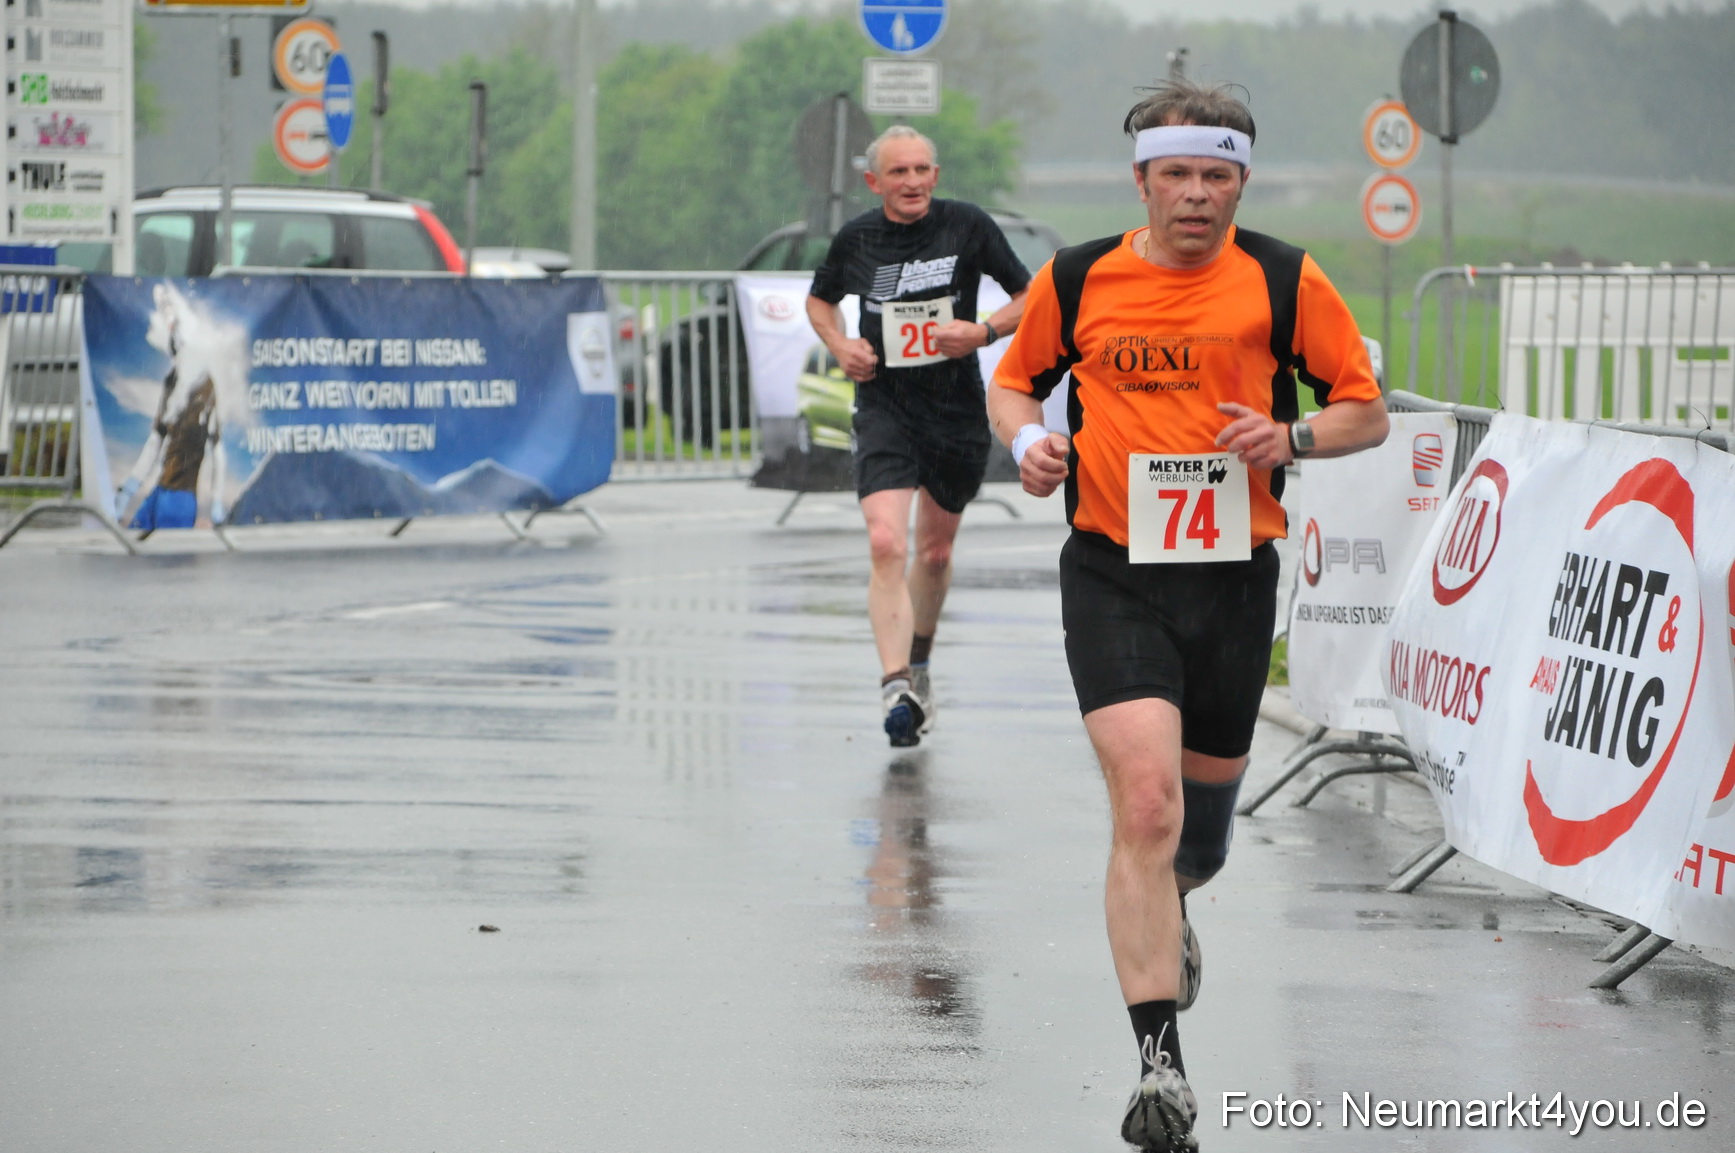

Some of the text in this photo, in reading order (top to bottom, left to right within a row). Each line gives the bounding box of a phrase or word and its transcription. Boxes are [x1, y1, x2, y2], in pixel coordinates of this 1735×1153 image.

[291, 40, 329, 75] 60
[1377, 119, 1410, 149] 60
[894, 305, 924, 313] MEYER
[252, 338, 376, 367] SAISONSTART
[380, 338, 413, 367] BEI
[1114, 347, 1200, 373] OEXL
[249, 382, 302, 410] GANZ
[413, 381, 445, 409] MIT
[446, 380, 517, 408] TOLLEN
[246, 423, 436, 453] WINTERANGEBOTEN
[1149, 460, 1204, 473] MEYER
[1149, 473, 1204, 483] WERBUNG
[1158, 488, 1220, 550] 74
[1442, 496, 1490, 573] KIA
[1314, 604, 1349, 624] UPGRADE
[1350, 606, 1366, 624] IST
[1658, 595, 1681, 653] &
[1390, 640, 1491, 726] KIA MOTORS
[1544, 655, 1664, 768] JÄNIG
